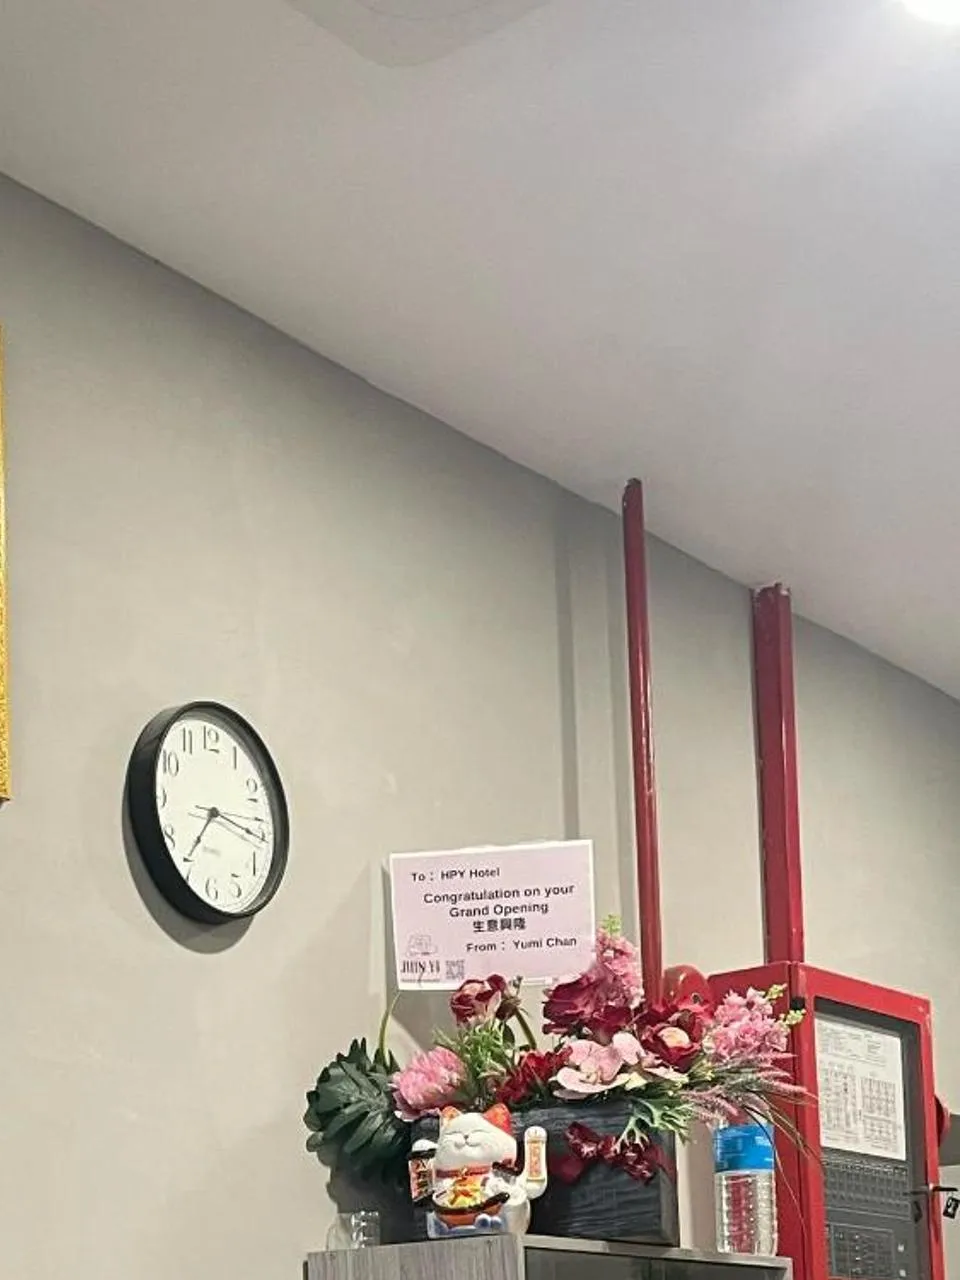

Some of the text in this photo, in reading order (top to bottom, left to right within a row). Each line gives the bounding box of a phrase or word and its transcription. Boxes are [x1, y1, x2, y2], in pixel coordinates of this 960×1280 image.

[183, 727, 193, 755] 11
[203, 725, 220, 754] 12
[162, 749, 180, 778] 10
[245, 778, 259, 803] 2
[163, 823, 176, 849] 8
[440, 869, 466, 880] HPY
[469, 867, 500, 879] Hotel
[204, 876, 218, 901] 6
[423, 885, 576, 905] Congratulation on your
[449, 903, 549, 918] Grand Opening
[512, 938, 543, 949] Yumi
[546, 937, 577, 948] Chan
